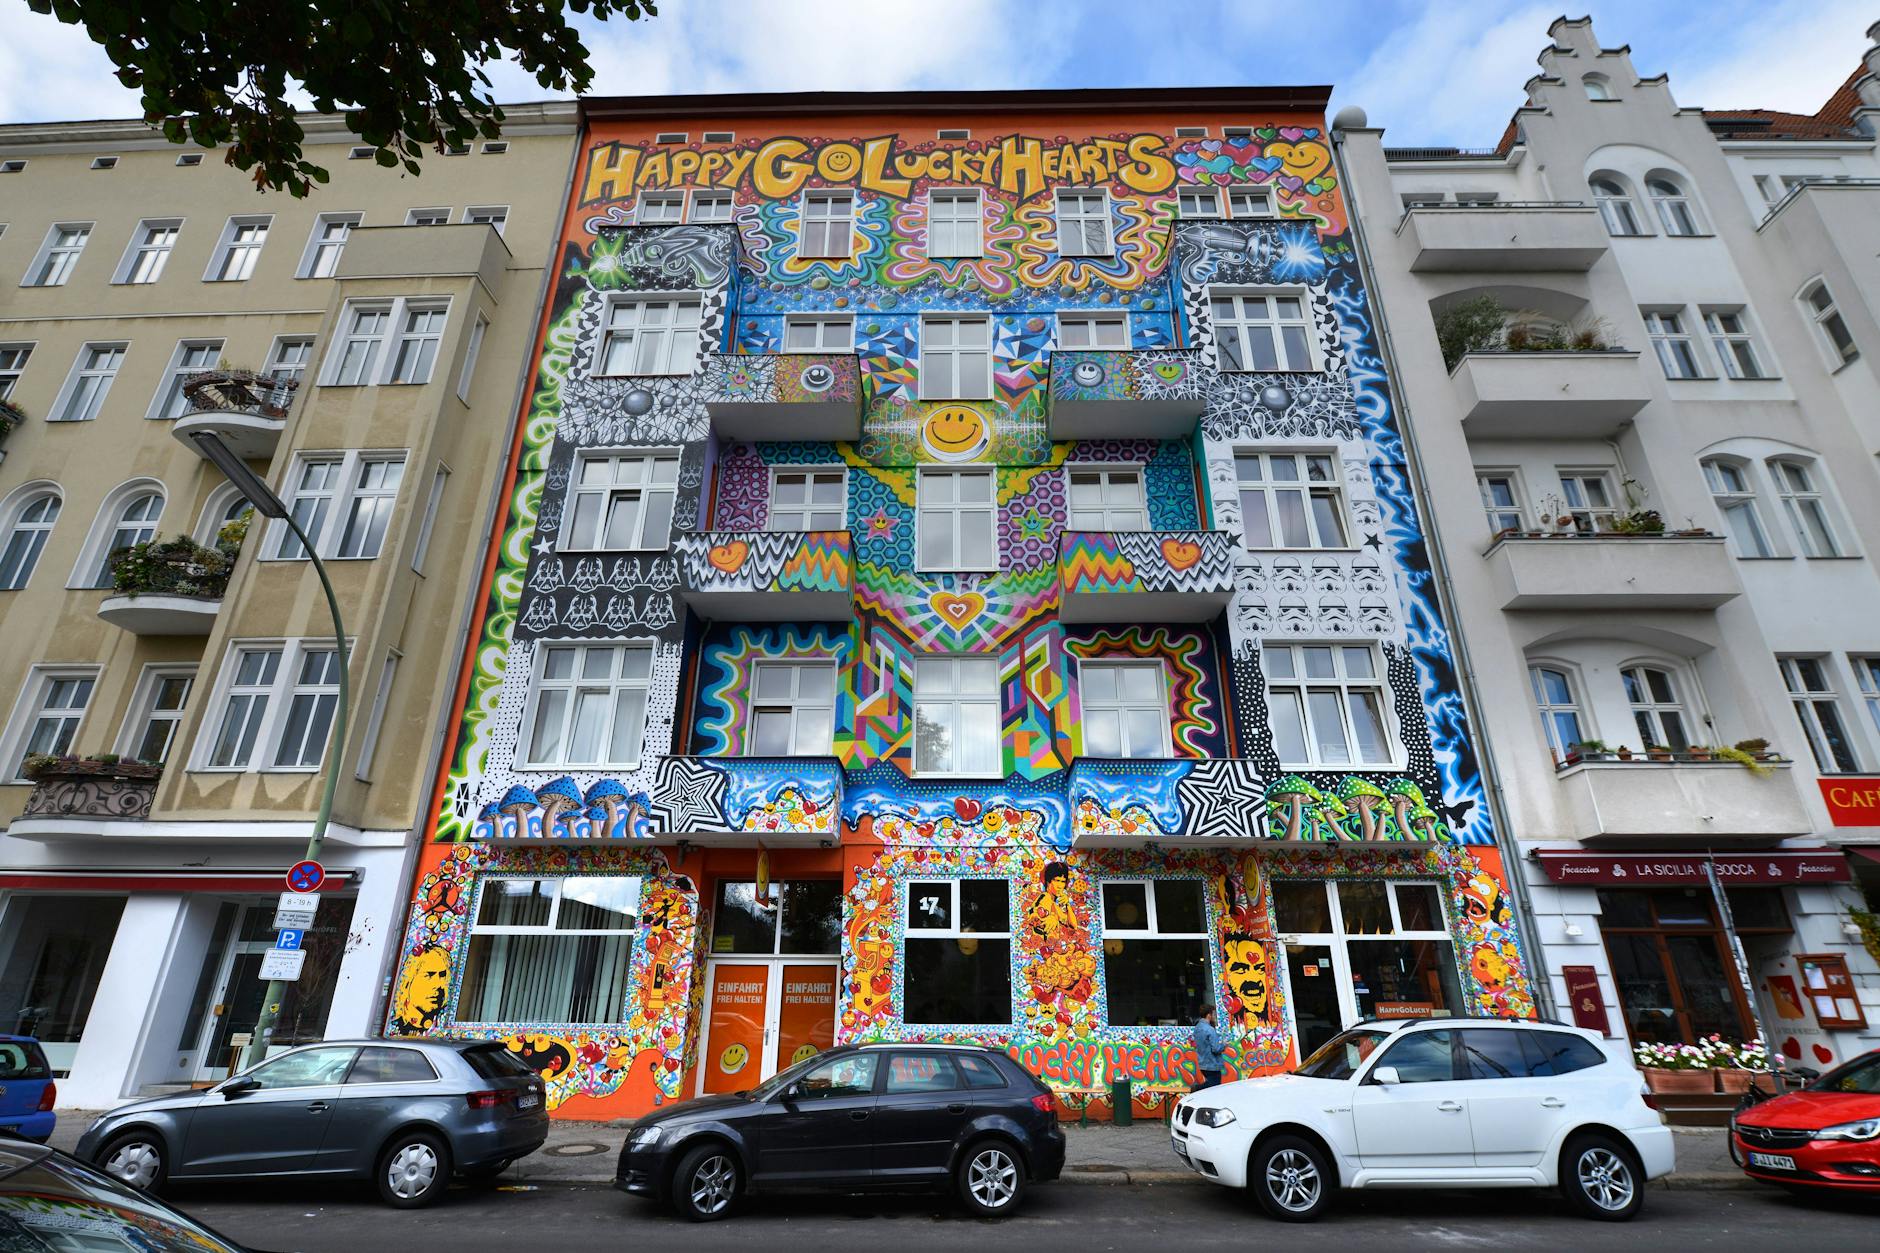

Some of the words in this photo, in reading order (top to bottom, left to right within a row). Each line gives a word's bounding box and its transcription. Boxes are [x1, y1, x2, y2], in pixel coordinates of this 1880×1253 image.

[1635, 864, 1653, 876] LA
[1654, 864, 1696, 876] SICILIA
[1715, 864, 1757, 876] BOCCA
[919, 896, 940, 915] 17
[280, 931, 296, 947] P
[717, 982, 764, 993] EINFAHRT
[786, 983, 832, 993] EINFAHRT
[716, 995, 732, 1003] FREI
[734, 995, 763, 1004] HALTEN!
[785, 995, 801, 1004] FREI
[803, 995, 832, 1004] HALTEN!
